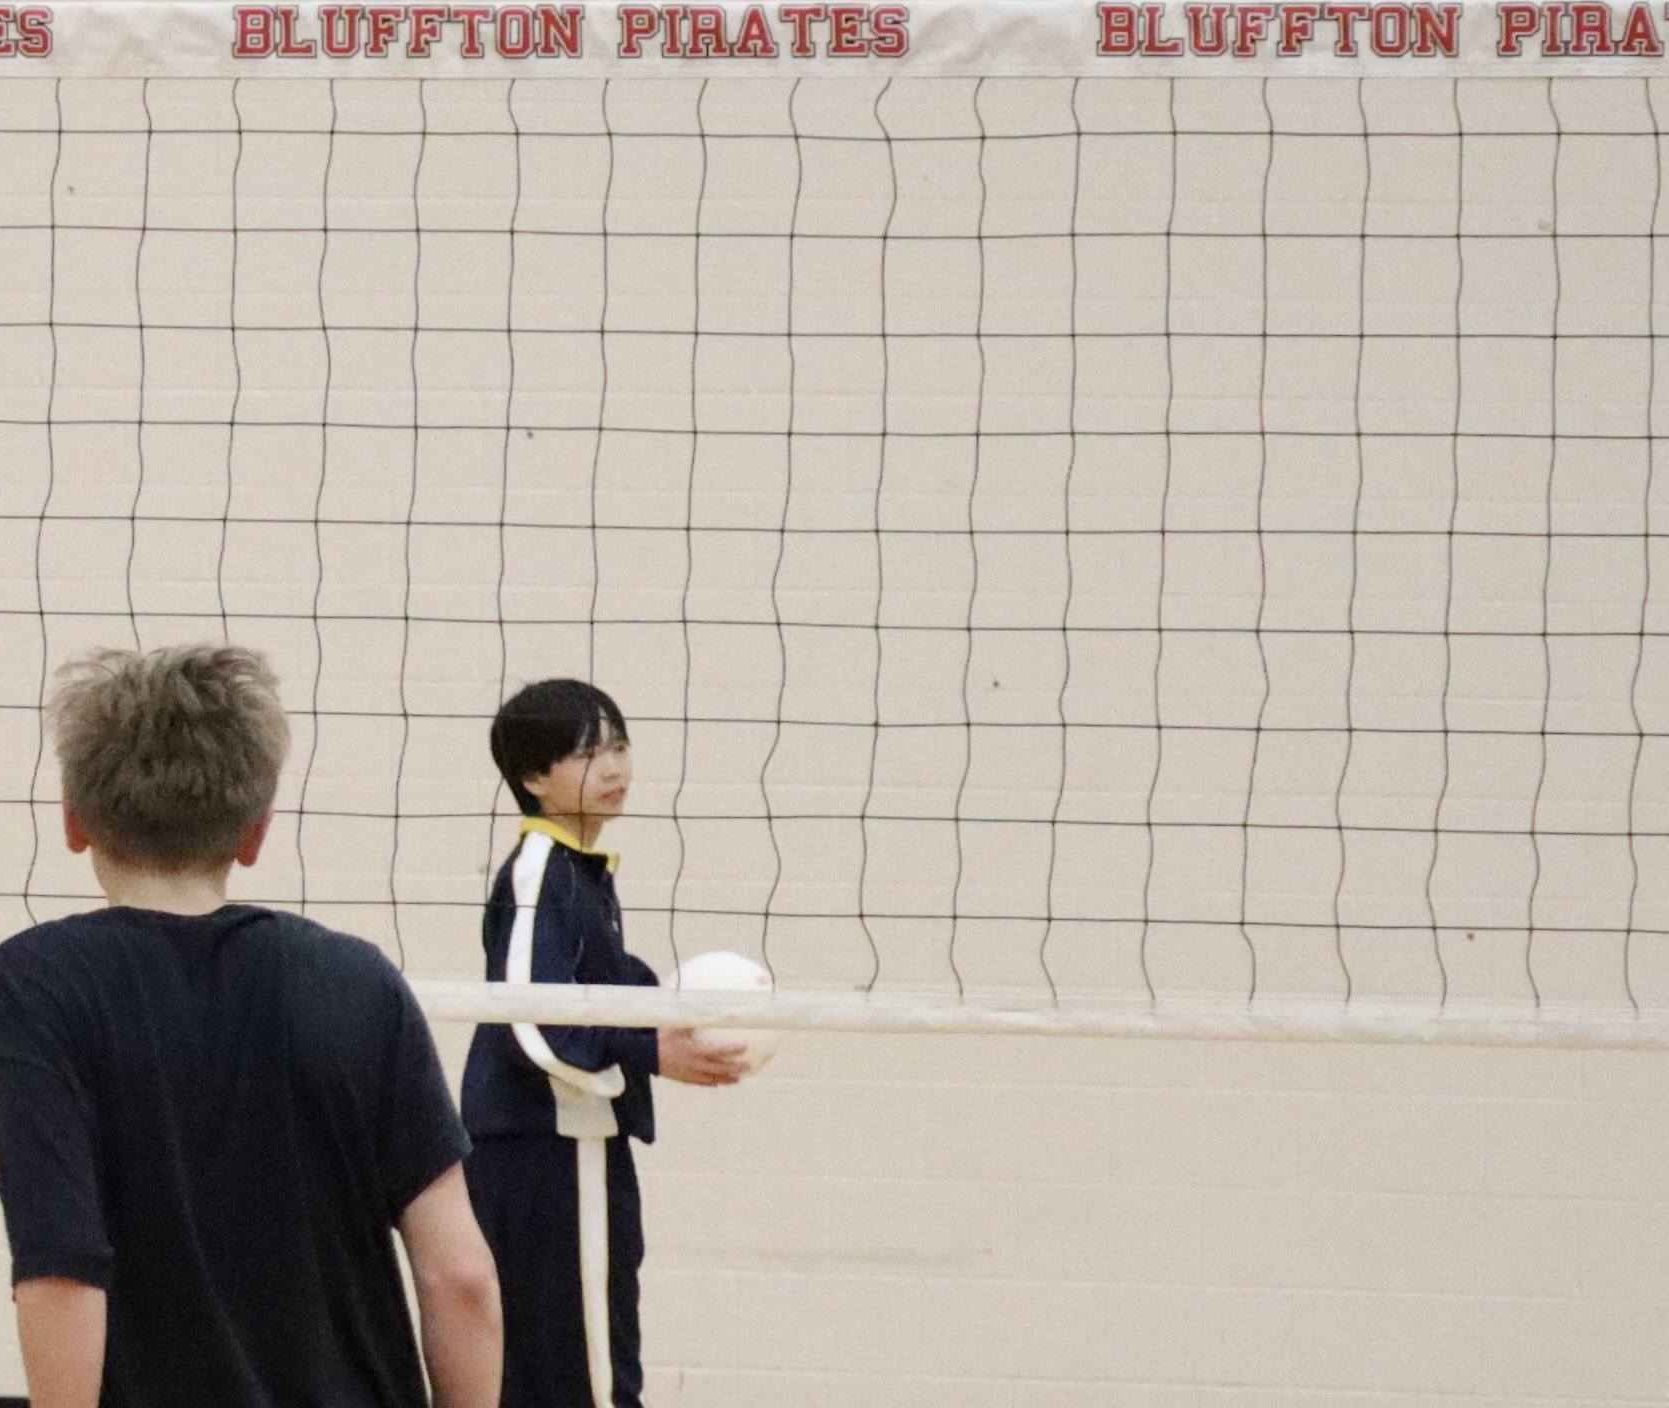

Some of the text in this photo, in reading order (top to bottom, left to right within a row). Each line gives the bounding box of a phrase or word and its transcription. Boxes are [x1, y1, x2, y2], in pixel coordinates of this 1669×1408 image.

[232, 5, 910, 58] BLUFFTON PIRATES
[1096, 2, 1669, 57] BLUFFTON PIRA
